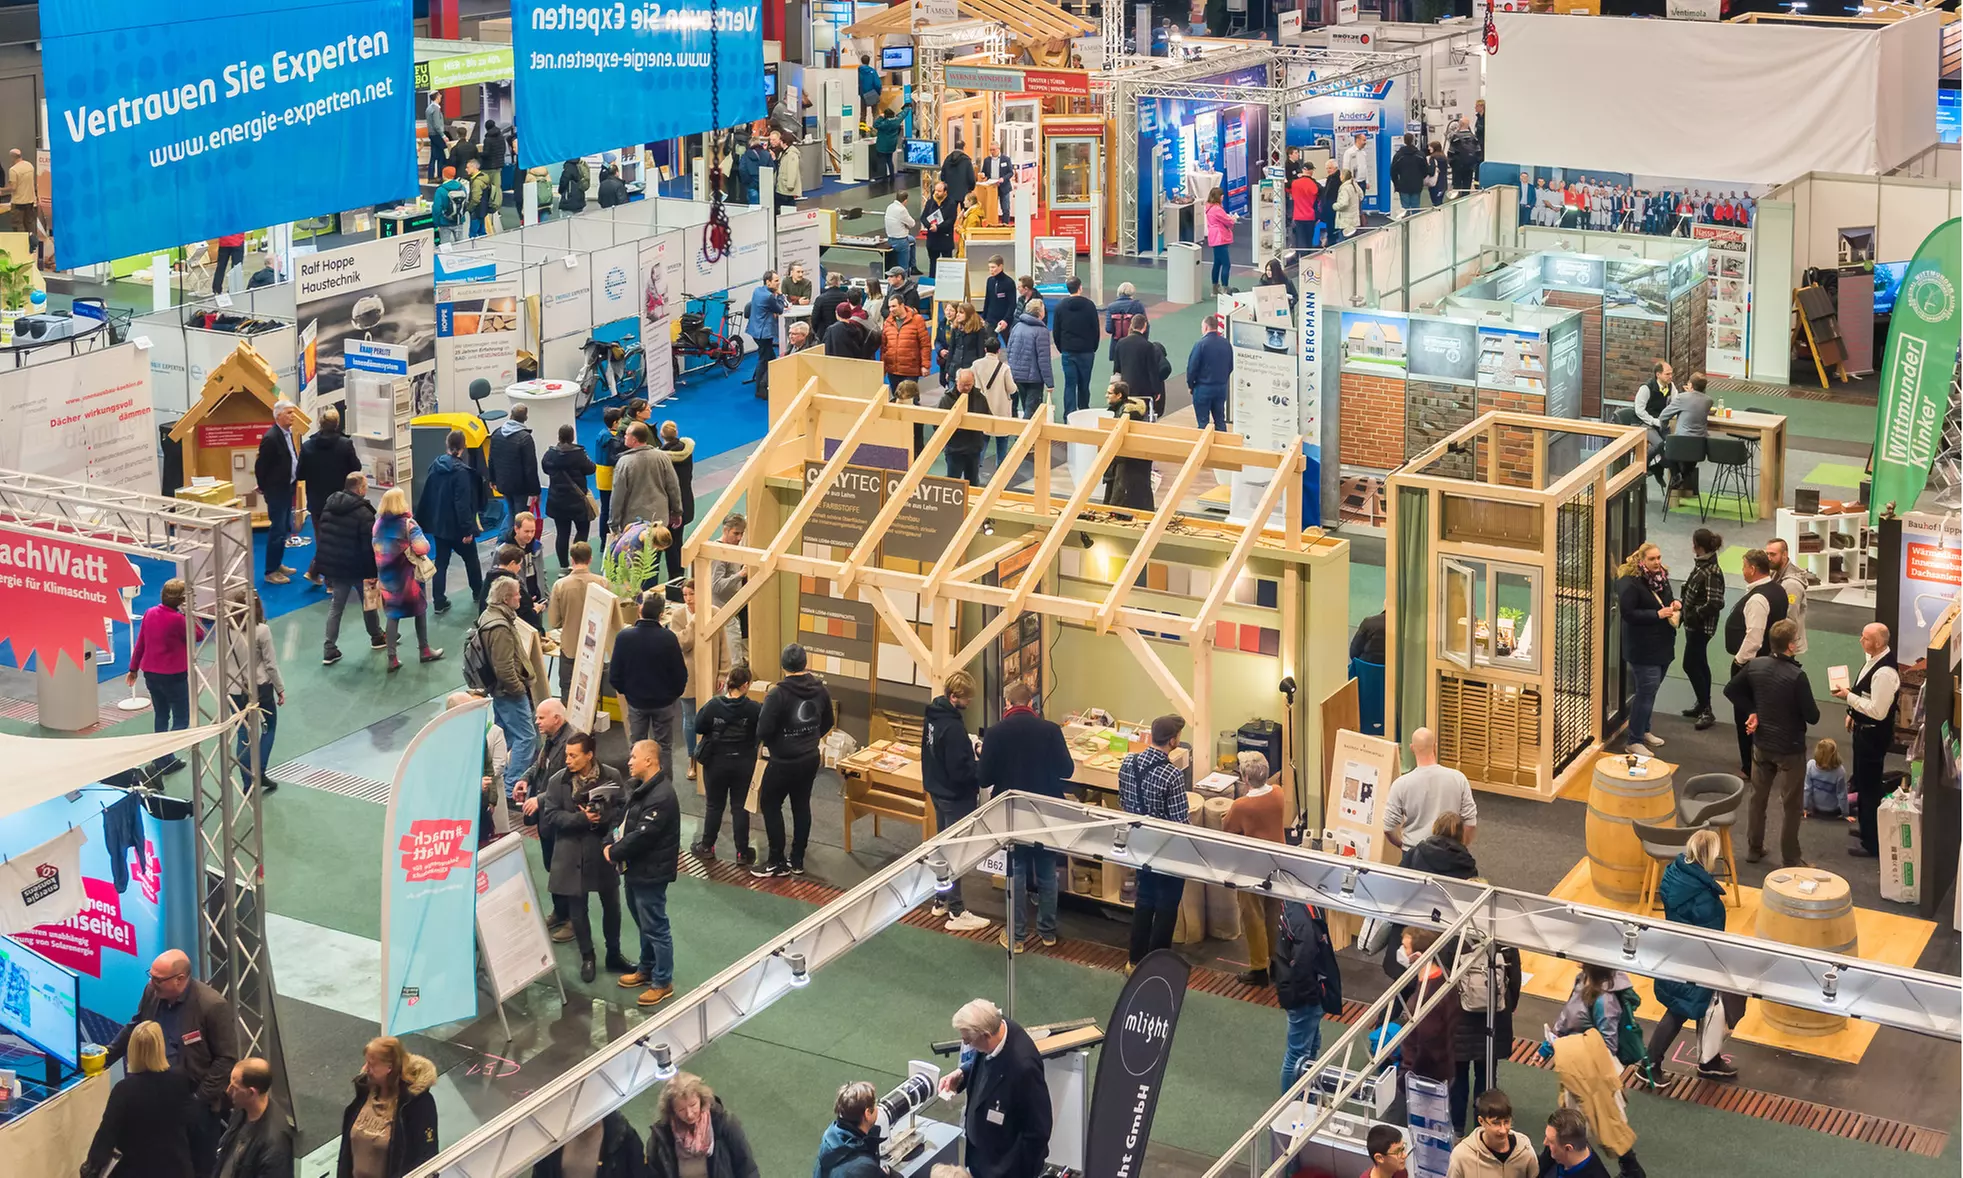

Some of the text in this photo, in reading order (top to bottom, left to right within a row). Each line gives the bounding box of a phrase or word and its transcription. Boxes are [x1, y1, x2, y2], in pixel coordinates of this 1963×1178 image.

[924, 5, 954, 15] TAMSEN
[64, 30, 390, 143] Vertrauen Sie Experten
[1050, 86, 1087, 94] WINTERGÄRTEN
[150, 76, 393, 168] www.energie-experten.net
[1338, 111, 1368, 119] Anders
[1175, 135, 1186, 193] Vaillant
[301, 255, 355, 277] Ralf Hoppe
[302, 273, 361, 294] Haustechnik
[440, 309, 449, 333] HOPPE
[1305, 291, 1317, 362] BERGMANN
[162, 362, 186, 372] EXPERTEN
[1888, 342, 1921, 458] Wittmunder
[50, 399, 134, 428] Dächer wirkungsvoll
[118, 407, 151, 422] dämmen
[1911, 395, 1937, 471] Klinker
[806, 467, 881, 493] CAYTEC
[841, 491, 856, 499] Lehm
[887, 478, 964, 506] CAYTEC
[823, 502, 860, 514] FARBSTOFFE
[922, 504, 938, 512] Lehm
[1908, 520, 1937, 531] Bauhof
[25, 576, 41, 590] für
[43, 580, 107, 604] Klimaschutz
[24, 877, 57, 896] konsens
[26, 884, 59, 903] energie
[48, 931, 89, 947] unabhängig
[62, 914, 130, 946] nseite!
[35, 938, 49, 946] von
[51, 940, 95, 957] Solarenergie
[1124, 1010, 1170, 1043] mlight
[1125, 1084, 1150, 1150] GmbH
